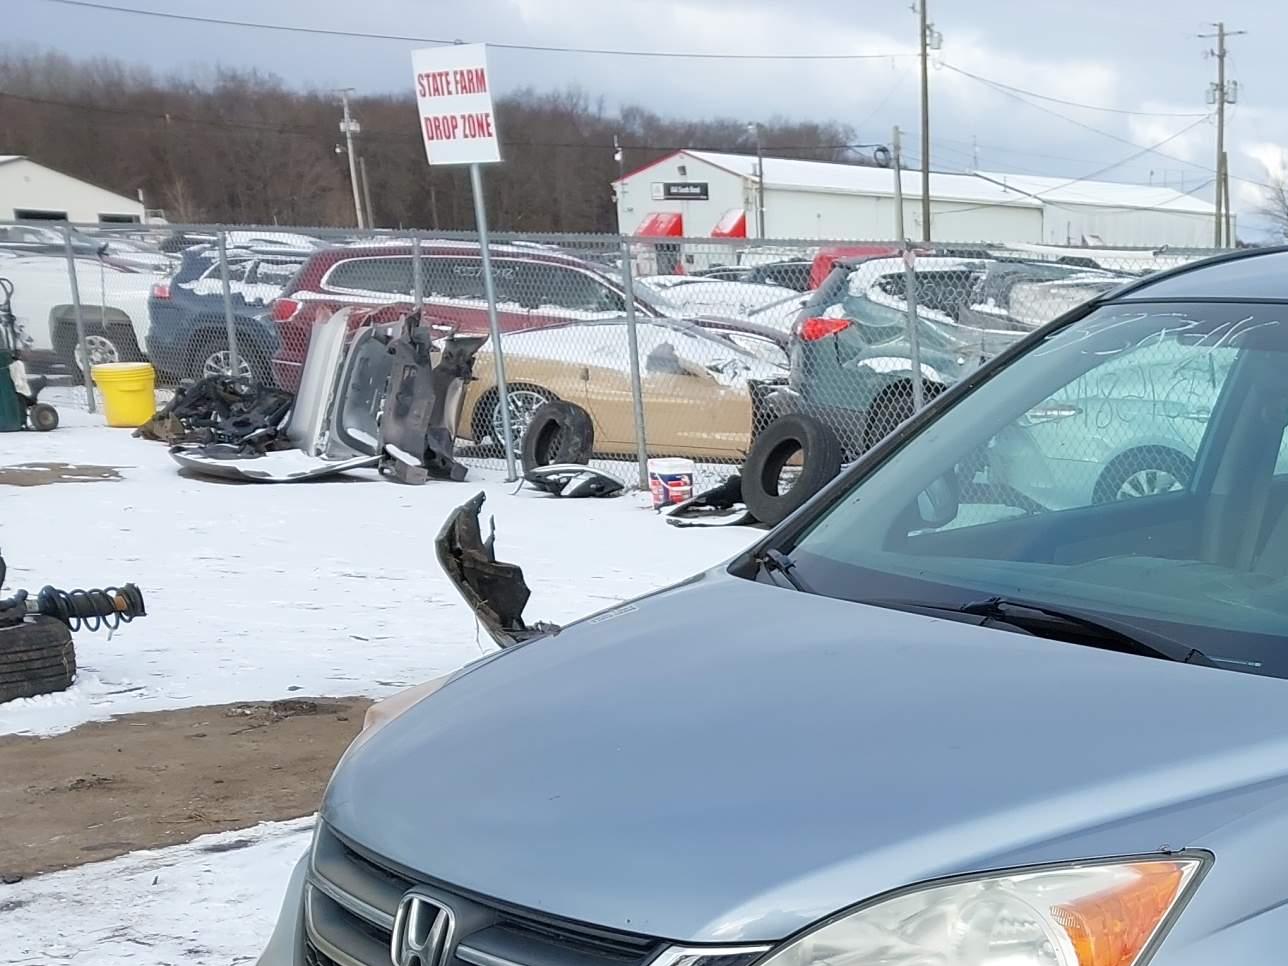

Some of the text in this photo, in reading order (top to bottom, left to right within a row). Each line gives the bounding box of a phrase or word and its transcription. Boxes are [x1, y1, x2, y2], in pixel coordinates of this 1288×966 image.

[417, 68, 487, 97] STATE FARM
[425, 113, 493, 141] DROP ZONE
